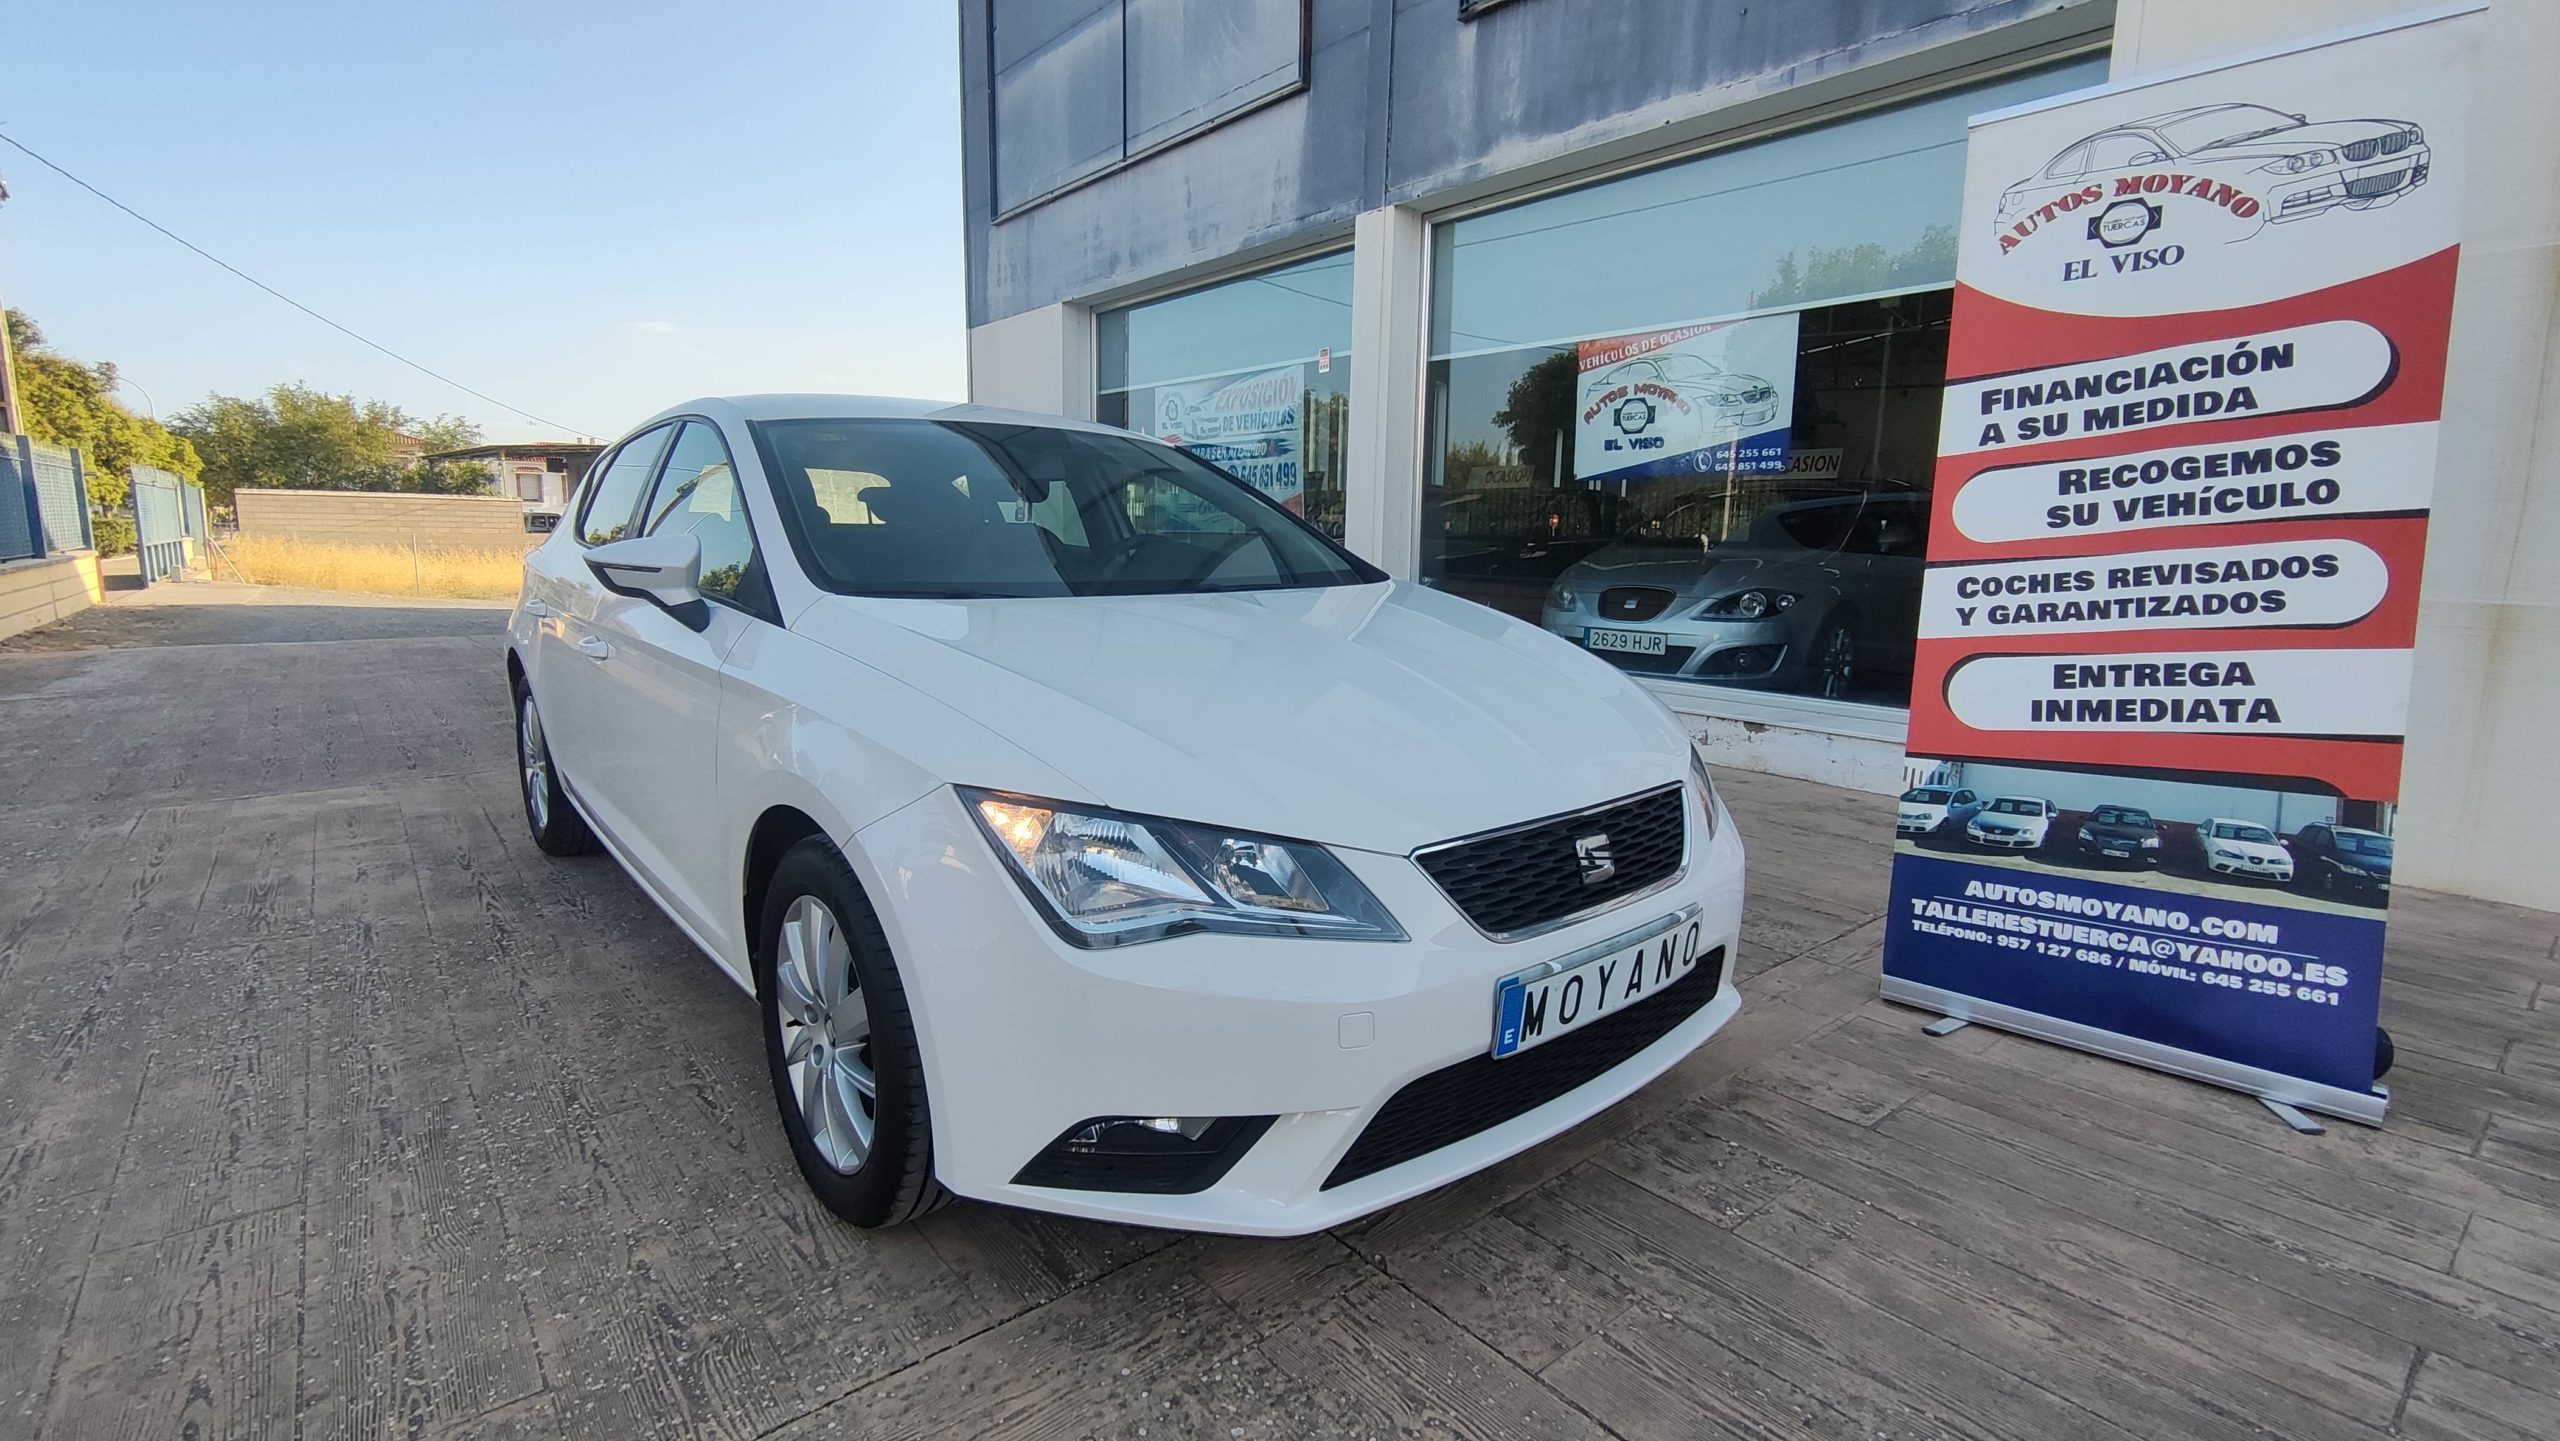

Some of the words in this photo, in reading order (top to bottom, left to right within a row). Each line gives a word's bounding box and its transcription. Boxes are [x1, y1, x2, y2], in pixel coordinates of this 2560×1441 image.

[1999, 184, 2104, 255] AUTOS
[2113, 174, 2260, 218] MOYANO
[2103, 219, 2146, 233] TUERCAS
[2062, 259, 2098, 281] EL
[2111, 245, 2185, 273] VISO
[1578, 342, 1639, 371] VEHÍCULOS
[1642, 336, 1658, 352] DE
[1215, 373, 1297, 412] EXPOSICIÓN
[1981, 341, 2294, 415] FINANCIACIÓN
[1222, 415, 1234, 432] DE
[1236, 407, 1295, 431] VEHÍCULOS
[1584, 385, 1628, 426] AUTOS
[1978, 422, 2005, 446] A
[2017, 412, 2068, 440] SU
[2083, 386, 2258, 432] MEDIDA
[1604, 439, 1623, 451] EL
[1628, 436, 1665, 450] VISO
[1716, 450, 1736, 459] 645
[1739, 449, 1759, 458] 255
[1762, 447, 1782, 457] 661
[1259, 463, 1274, 488] 851
[1276, 461, 1297, 487] 499
[1714, 463, 1735, 472] 645
[1738, 461, 1756, 471] 851
[1759, 460, 1782, 470] 499
[1787, 455, 1840, 473] ASION
[2058, 440, 2342, 496] RECOGEMOS
[2046, 502, 2100, 529] SU
[1956, 570, 2096, 599] COCHES
[2107, 554, 2340, 590] REVISADOS
[1956, 606, 1977, 627] Y
[1987, 590, 2287, 625] GARANTIZADOS
[1592, 632, 1628, 649] 2629
[1632, 635, 1662, 651] HJR
[2053, 661, 2256, 690] ENTREGA
[2030, 698, 2282, 724] INMEDIATA
[1964, 880, 2279, 945] AUTOSMOYANO.COM
[1911, 898, 2349, 987] TALLERESTUERCA@YAHOO.ES
[1911, 919, 1993, 945] TELÉFONO:
[1997, 934, 2031, 951] 957
[2036, 942, 2072, 958] 127
[2075, 948, 2112, 967] 686
[2115, 956, 2125, 969] /
[2128, 958, 2197, 982] MÓVIL:
[2202, 971, 2243, 989] 645
[2248, 978, 2291, 997] 255
[2296, 987, 2339, 1006] 661
[1503, 1028, 1515, 1044] E
[1519, 920, 1700, 1043] MOYANO
